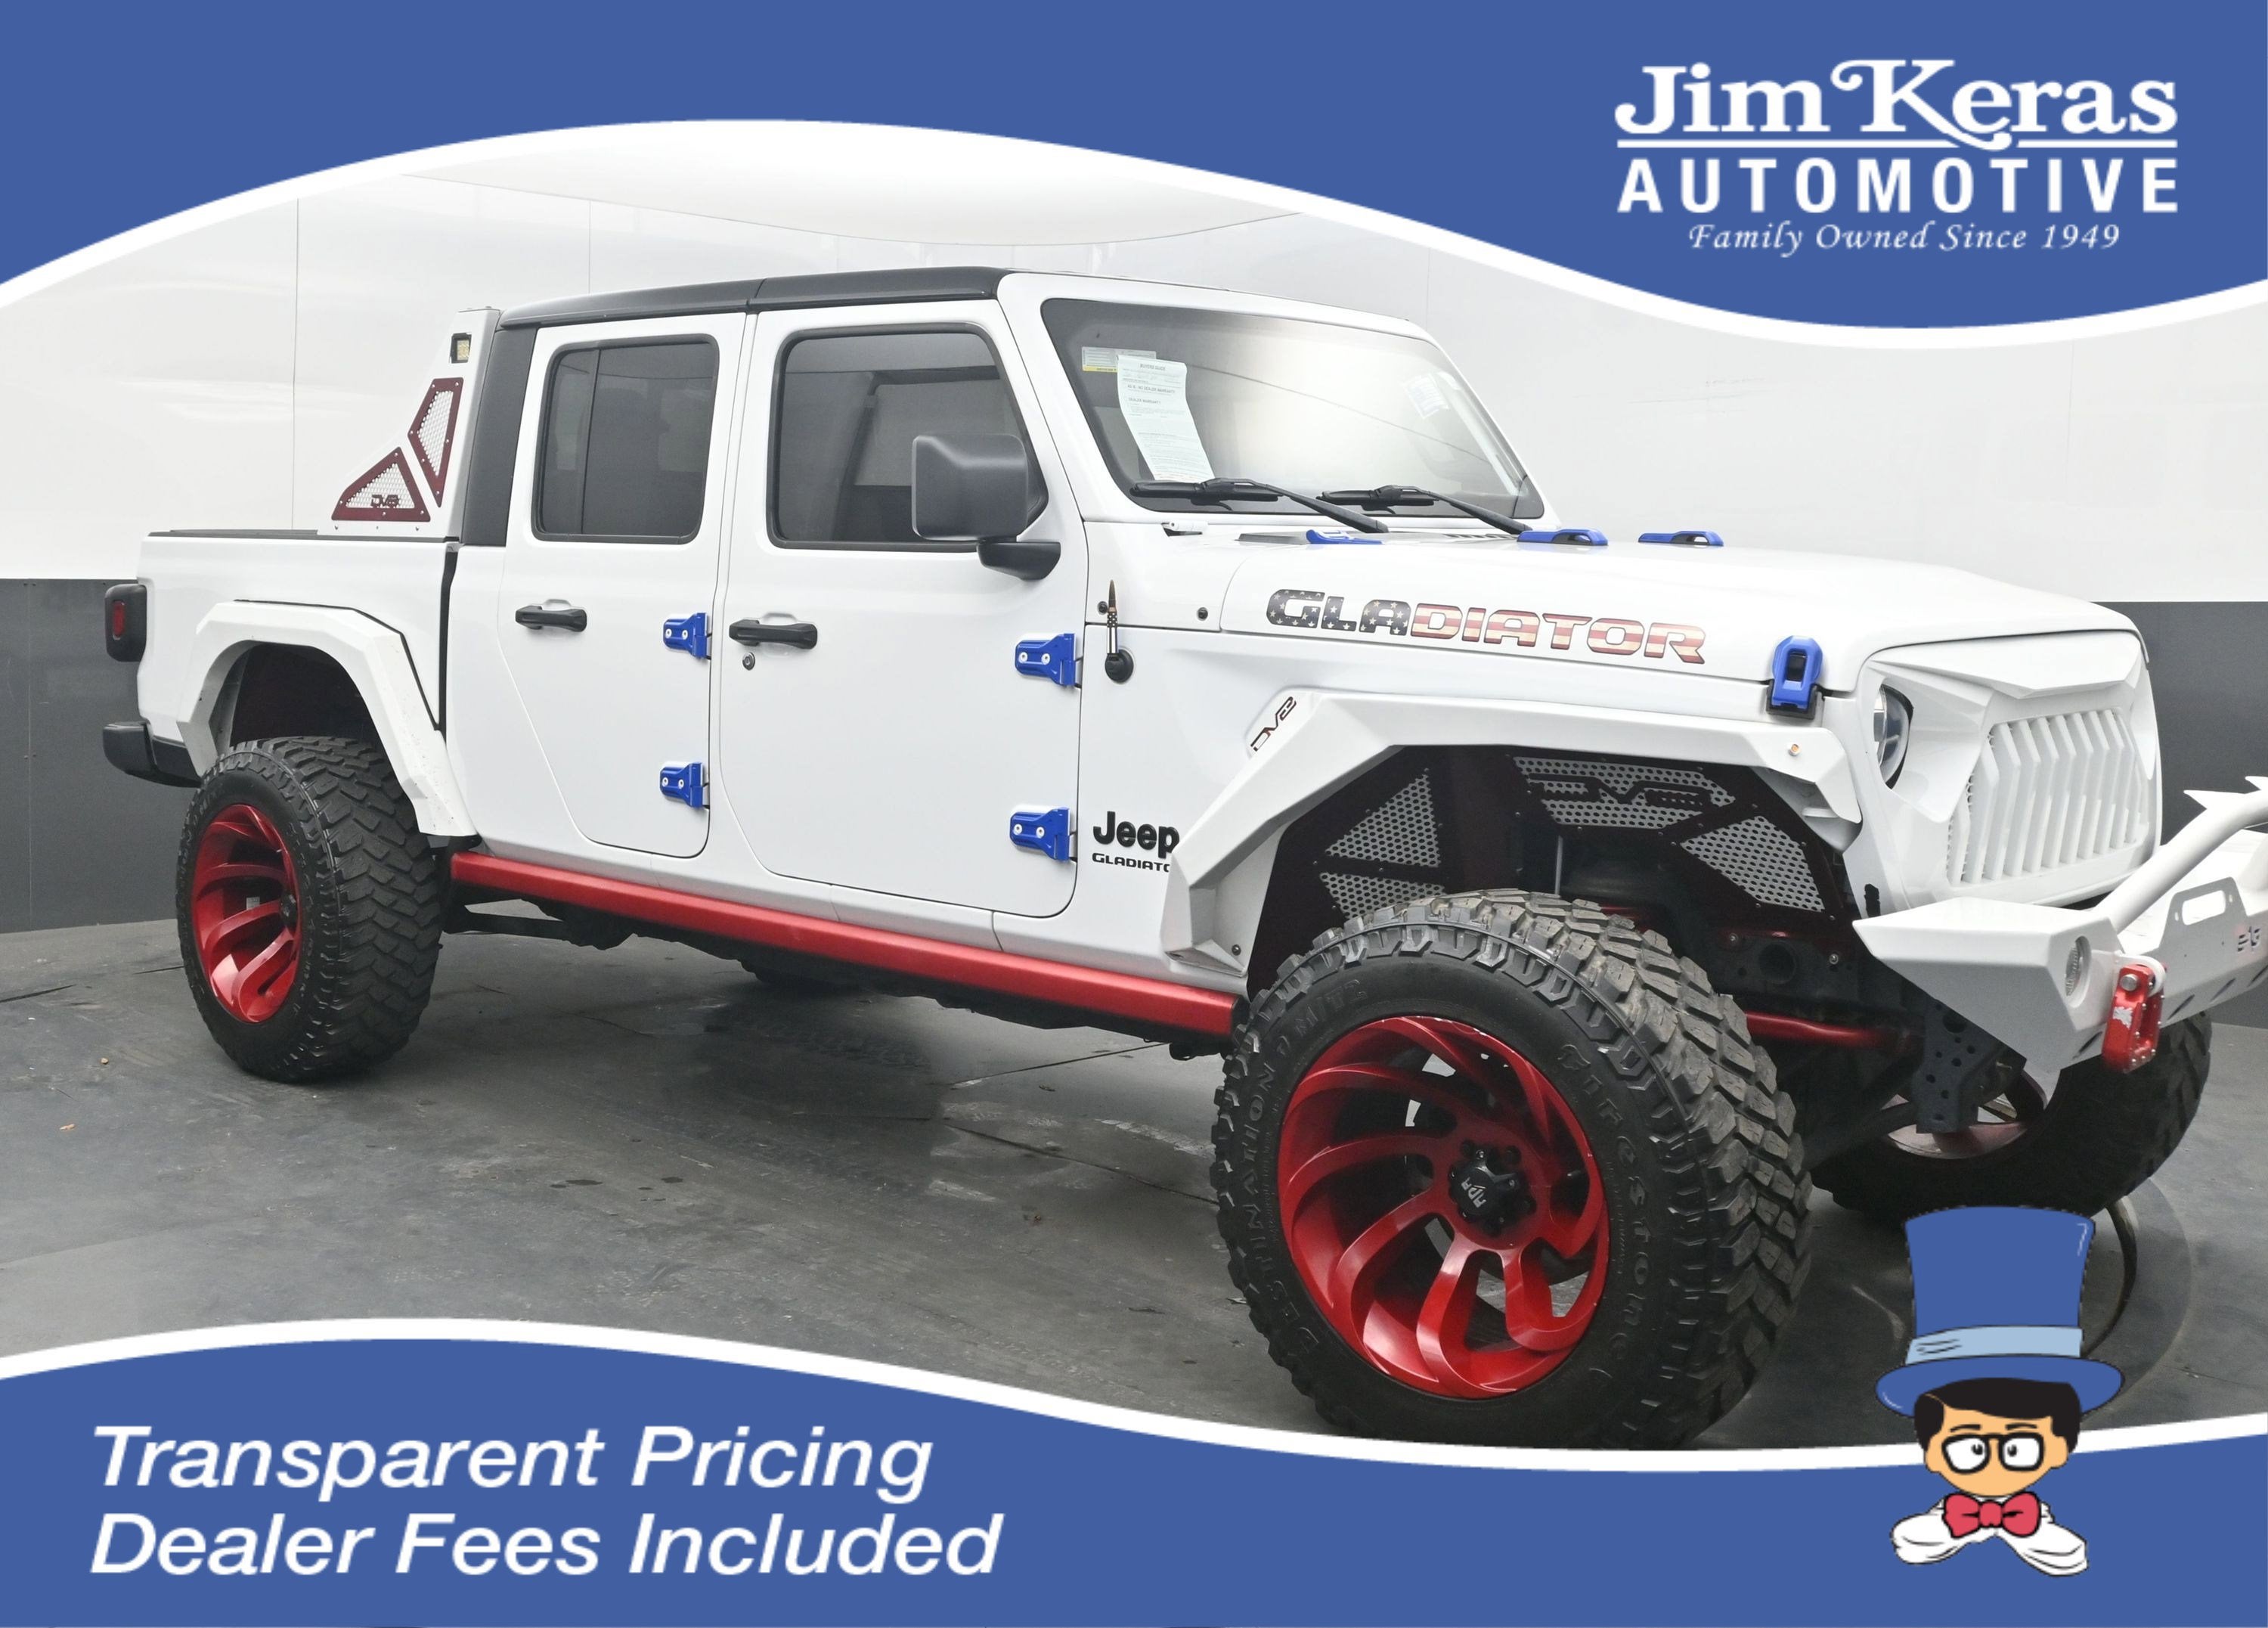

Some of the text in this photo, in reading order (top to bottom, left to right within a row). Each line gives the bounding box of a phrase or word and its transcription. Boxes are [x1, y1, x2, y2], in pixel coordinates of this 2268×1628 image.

[1266, 588, 1706, 665] GLADIATOR
[1093, 811, 1180, 859] Jeep
[1092, 852, 1170, 873] GLADIATO
